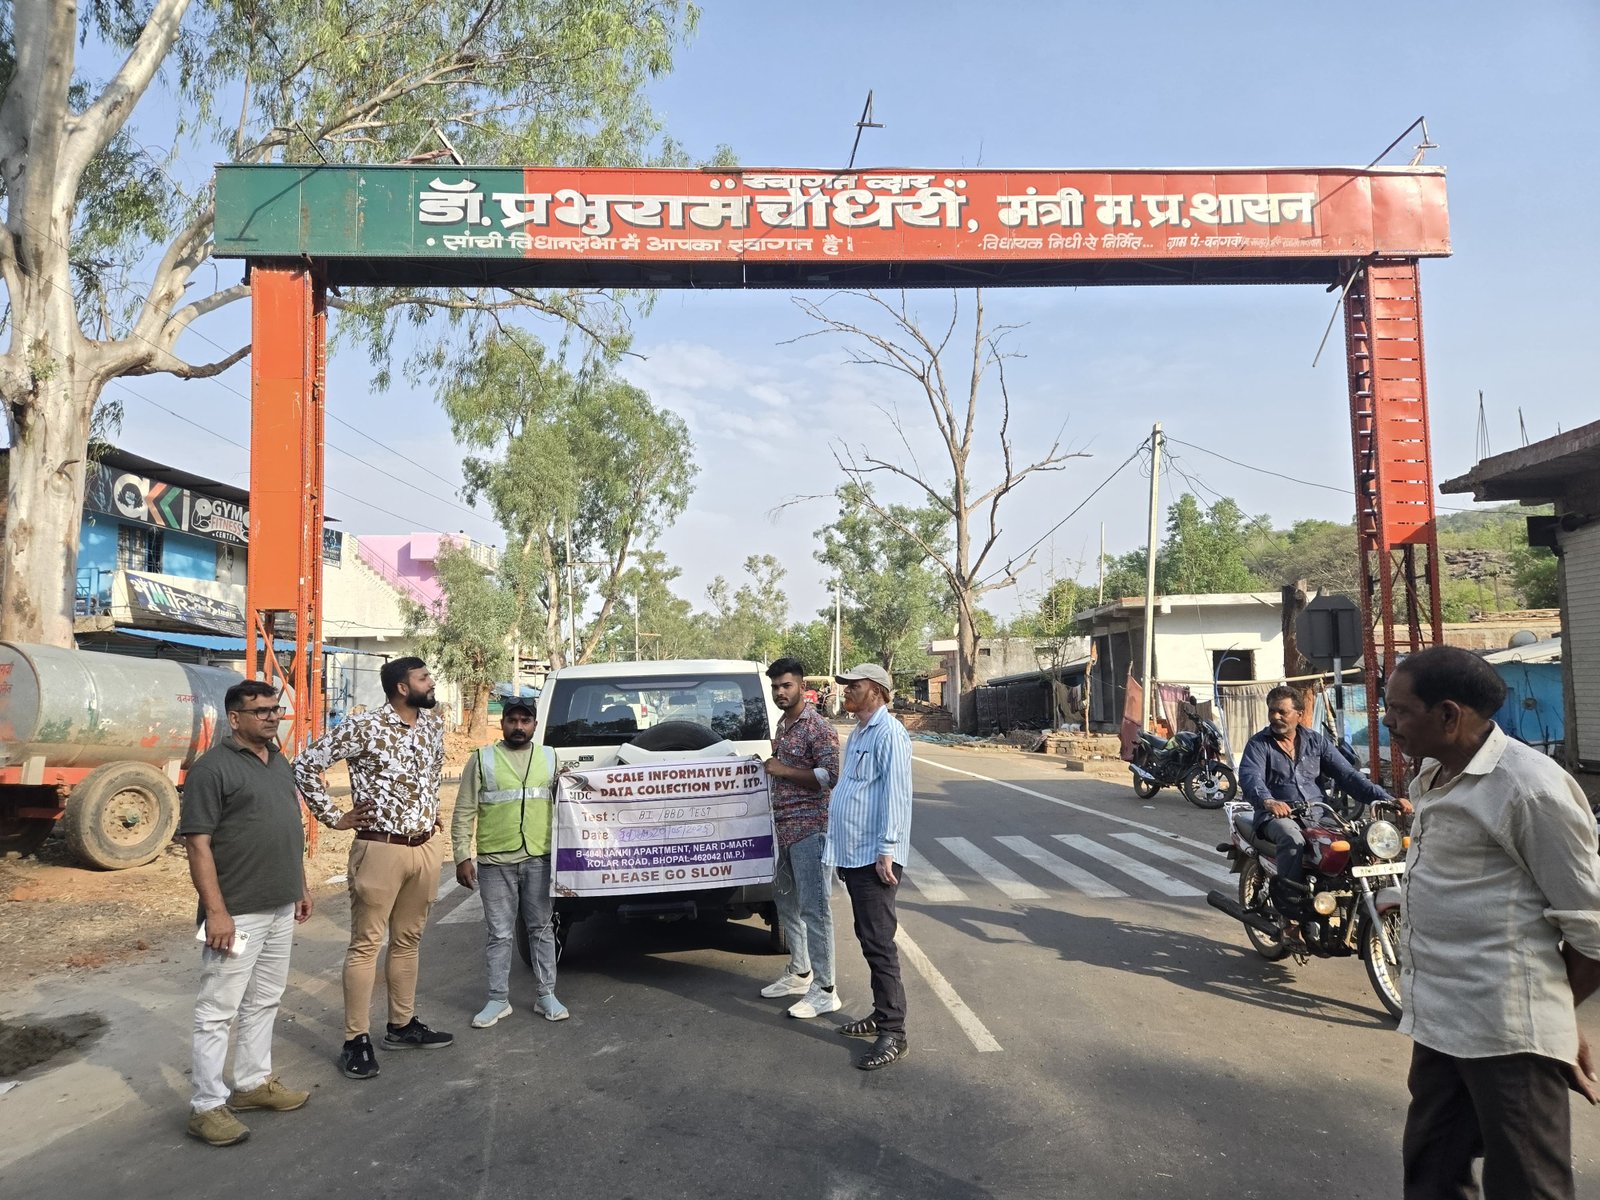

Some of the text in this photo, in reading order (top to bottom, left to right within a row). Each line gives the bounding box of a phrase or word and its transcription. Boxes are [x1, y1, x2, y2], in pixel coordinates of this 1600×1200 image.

[743, 174, 858, 189] स्वागत
[997, 187, 1083, 227] मंत्री
[443, 231, 502, 250] सांची
[619, 233, 640, 251] में
[646, 236, 721, 251] आपका
[728, 238, 813, 252] स्वागत
[982, 234, 1043, 250] विधायक
[212, 500, 243, 521] GYM
[211, 516, 242, 535] FITNESS
[215, 531, 236, 541] CENTER
[606, 764, 758, 783] SCALE INFORMATIVE AND
[600, 777, 762, 797] DATA COLLECTION PVT. LTD.
[689, 807, 711, 817] TEST
[634, 845, 691, 855] APARTMENT,
[693, 843, 718, 852] NEAR
[720, 840, 755, 850] D-MART,
[587, 859, 619, 868] KOLAR
[621, 857, 650, 867] ROAD,
[653, 853, 721, 865] BHOPAL-462042
[602, 865, 732, 884] PLEASE GO SLOW
